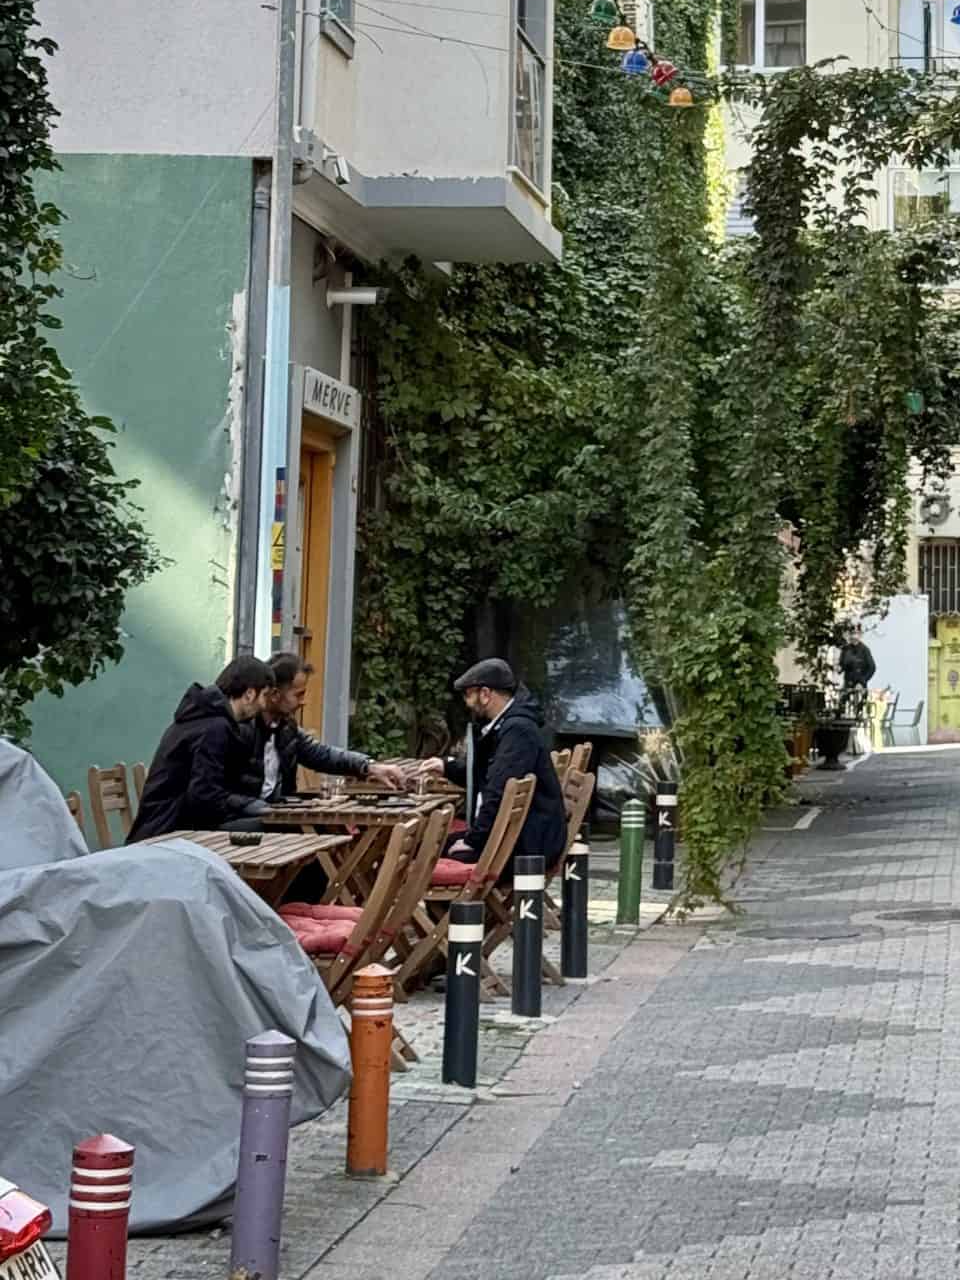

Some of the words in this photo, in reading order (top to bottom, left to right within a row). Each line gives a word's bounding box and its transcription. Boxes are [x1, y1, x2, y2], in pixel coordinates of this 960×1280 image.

[312, 378, 352, 417] MERVE
[564, 861, 581, 881] K
[519, 898, 538, 921] K
[455, 952, 476, 977] K
